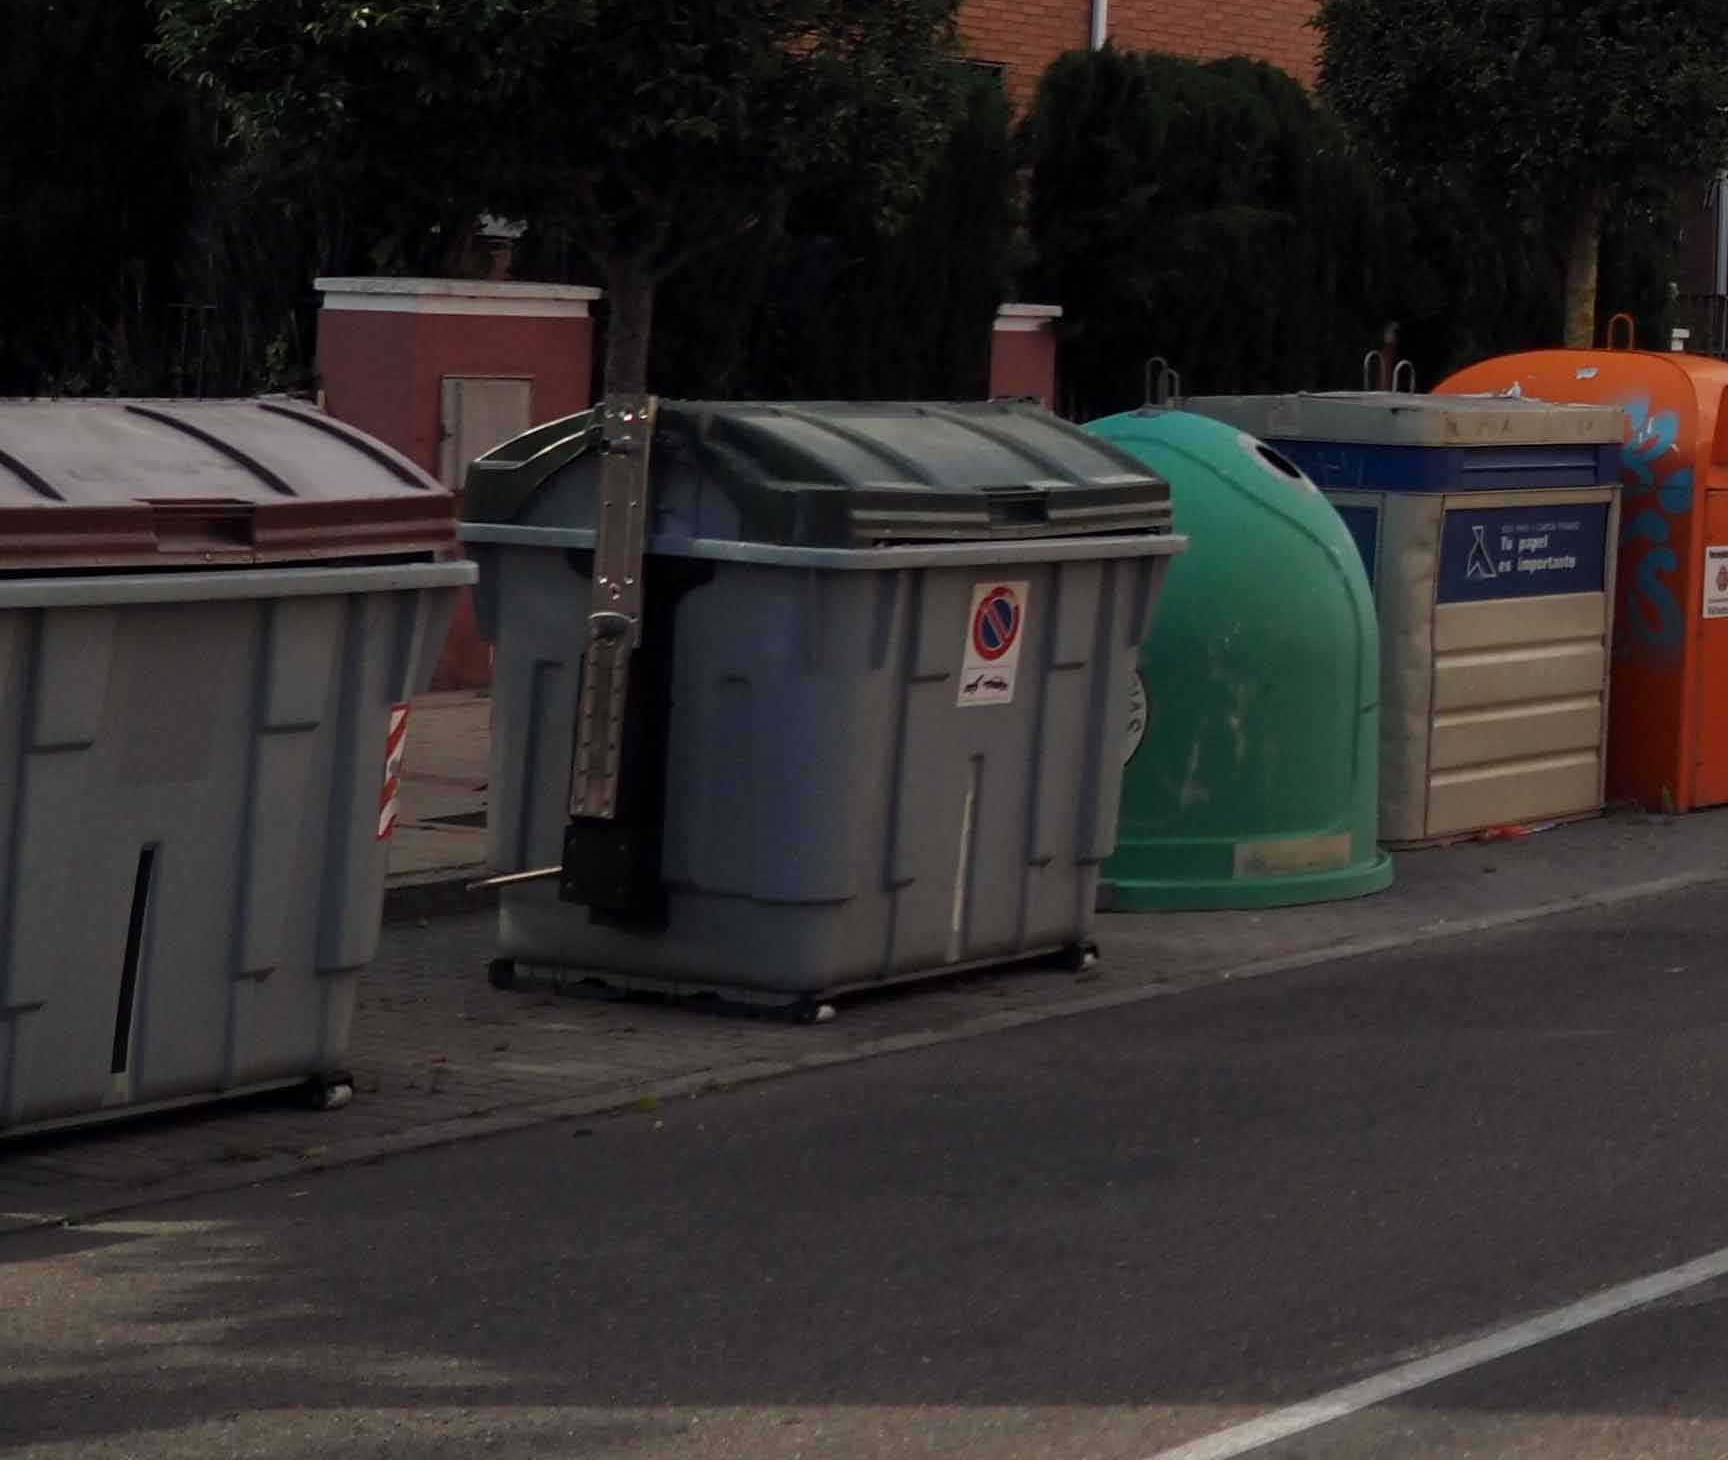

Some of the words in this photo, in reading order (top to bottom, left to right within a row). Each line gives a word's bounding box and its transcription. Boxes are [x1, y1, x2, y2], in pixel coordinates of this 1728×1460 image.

[1500, 536, 1513, 551] Tu
[1518, 534, 1548, 553] papel
[1498, 560, 1511, 572] es
[1517, 555, 1576, 575] importante
